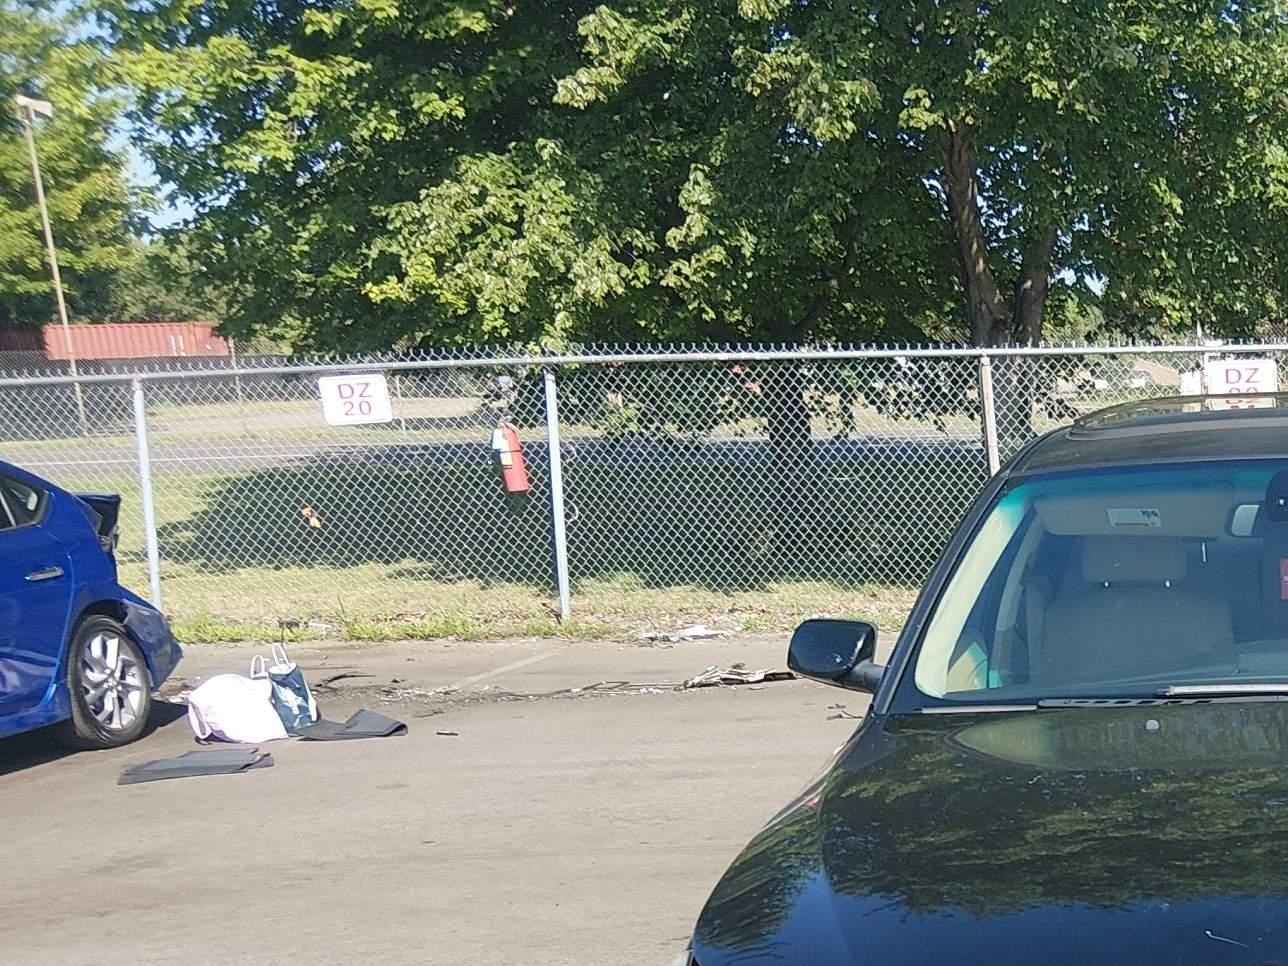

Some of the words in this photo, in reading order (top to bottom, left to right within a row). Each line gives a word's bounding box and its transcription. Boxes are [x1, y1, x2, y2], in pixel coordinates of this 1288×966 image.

[1225, 367, 1260, 385] DZ
[337, 382, 373, 400] DZ
[342, 400, 372, 416] 20
